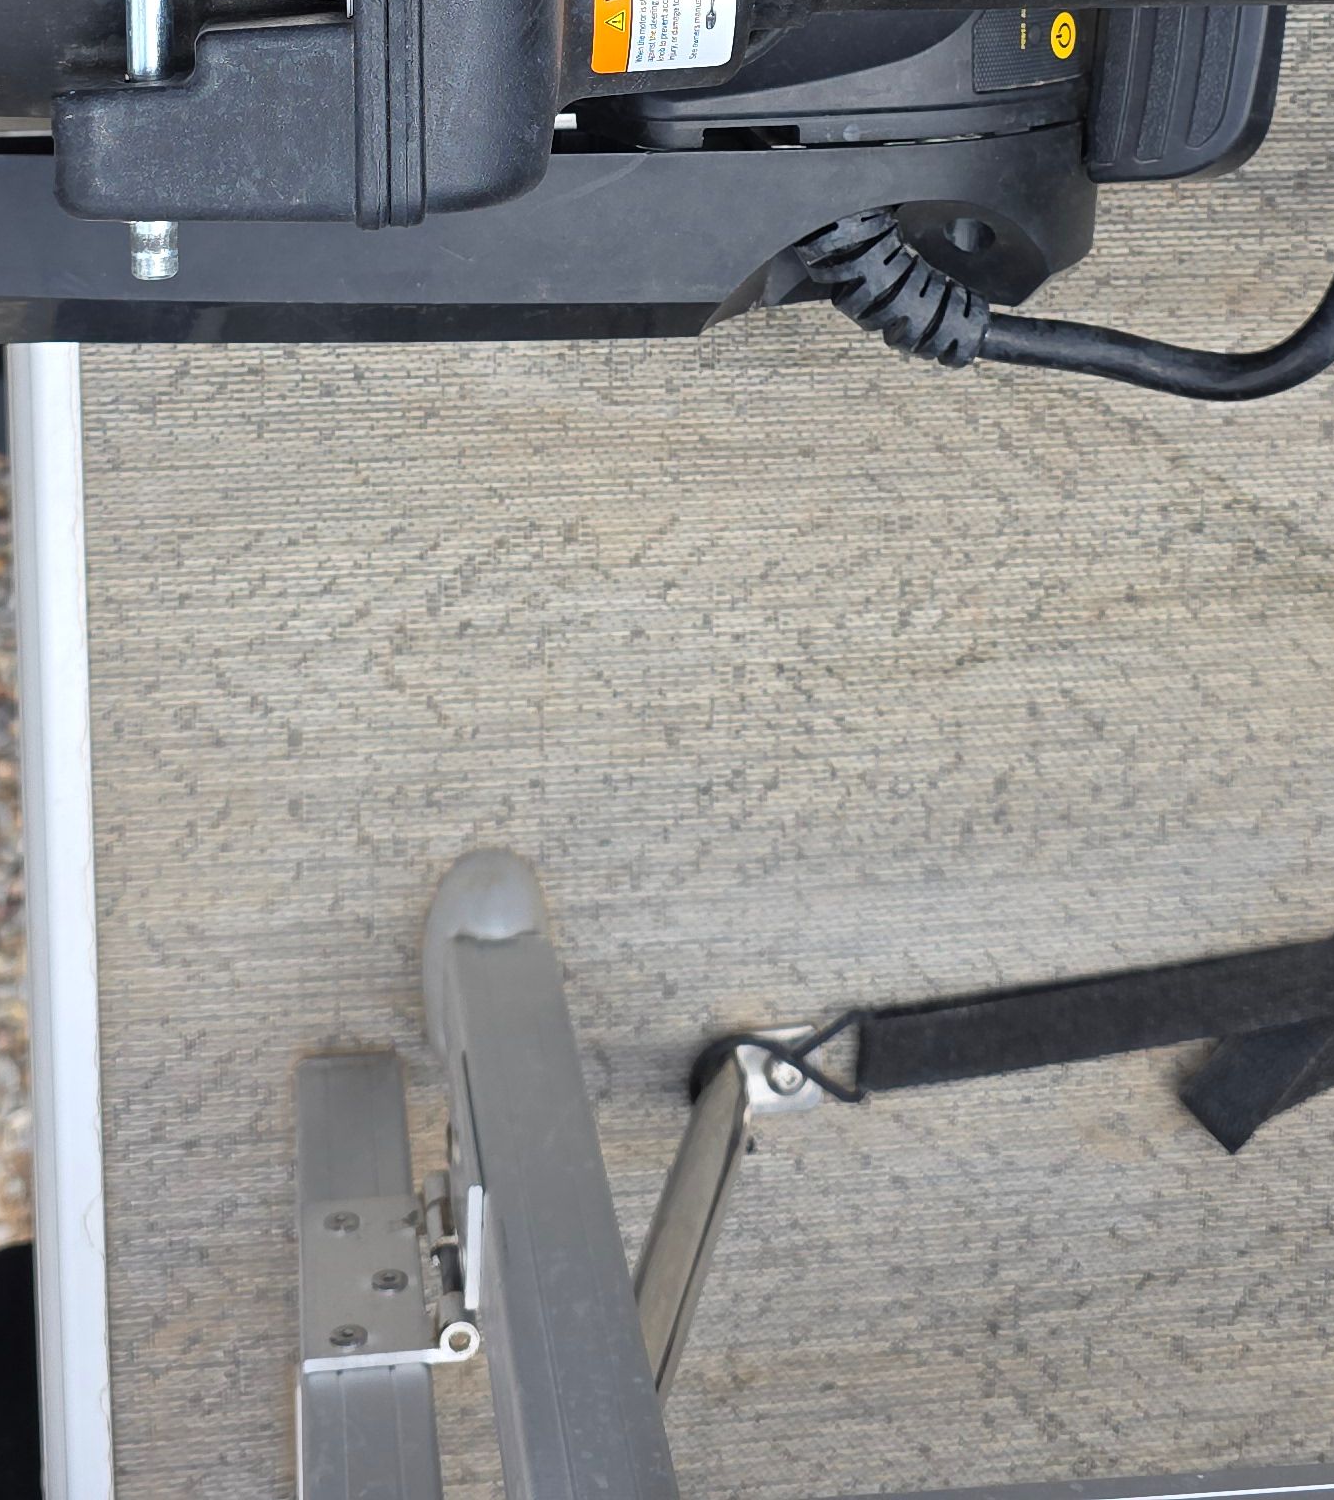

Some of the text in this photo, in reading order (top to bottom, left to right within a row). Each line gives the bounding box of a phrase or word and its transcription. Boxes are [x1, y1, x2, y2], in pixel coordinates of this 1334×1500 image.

[660, 14, 668, 39] prevent
[671, 8, 681, 35] damage
[637, 36, 645, 45] the
[688, 49, 697, 59] See
